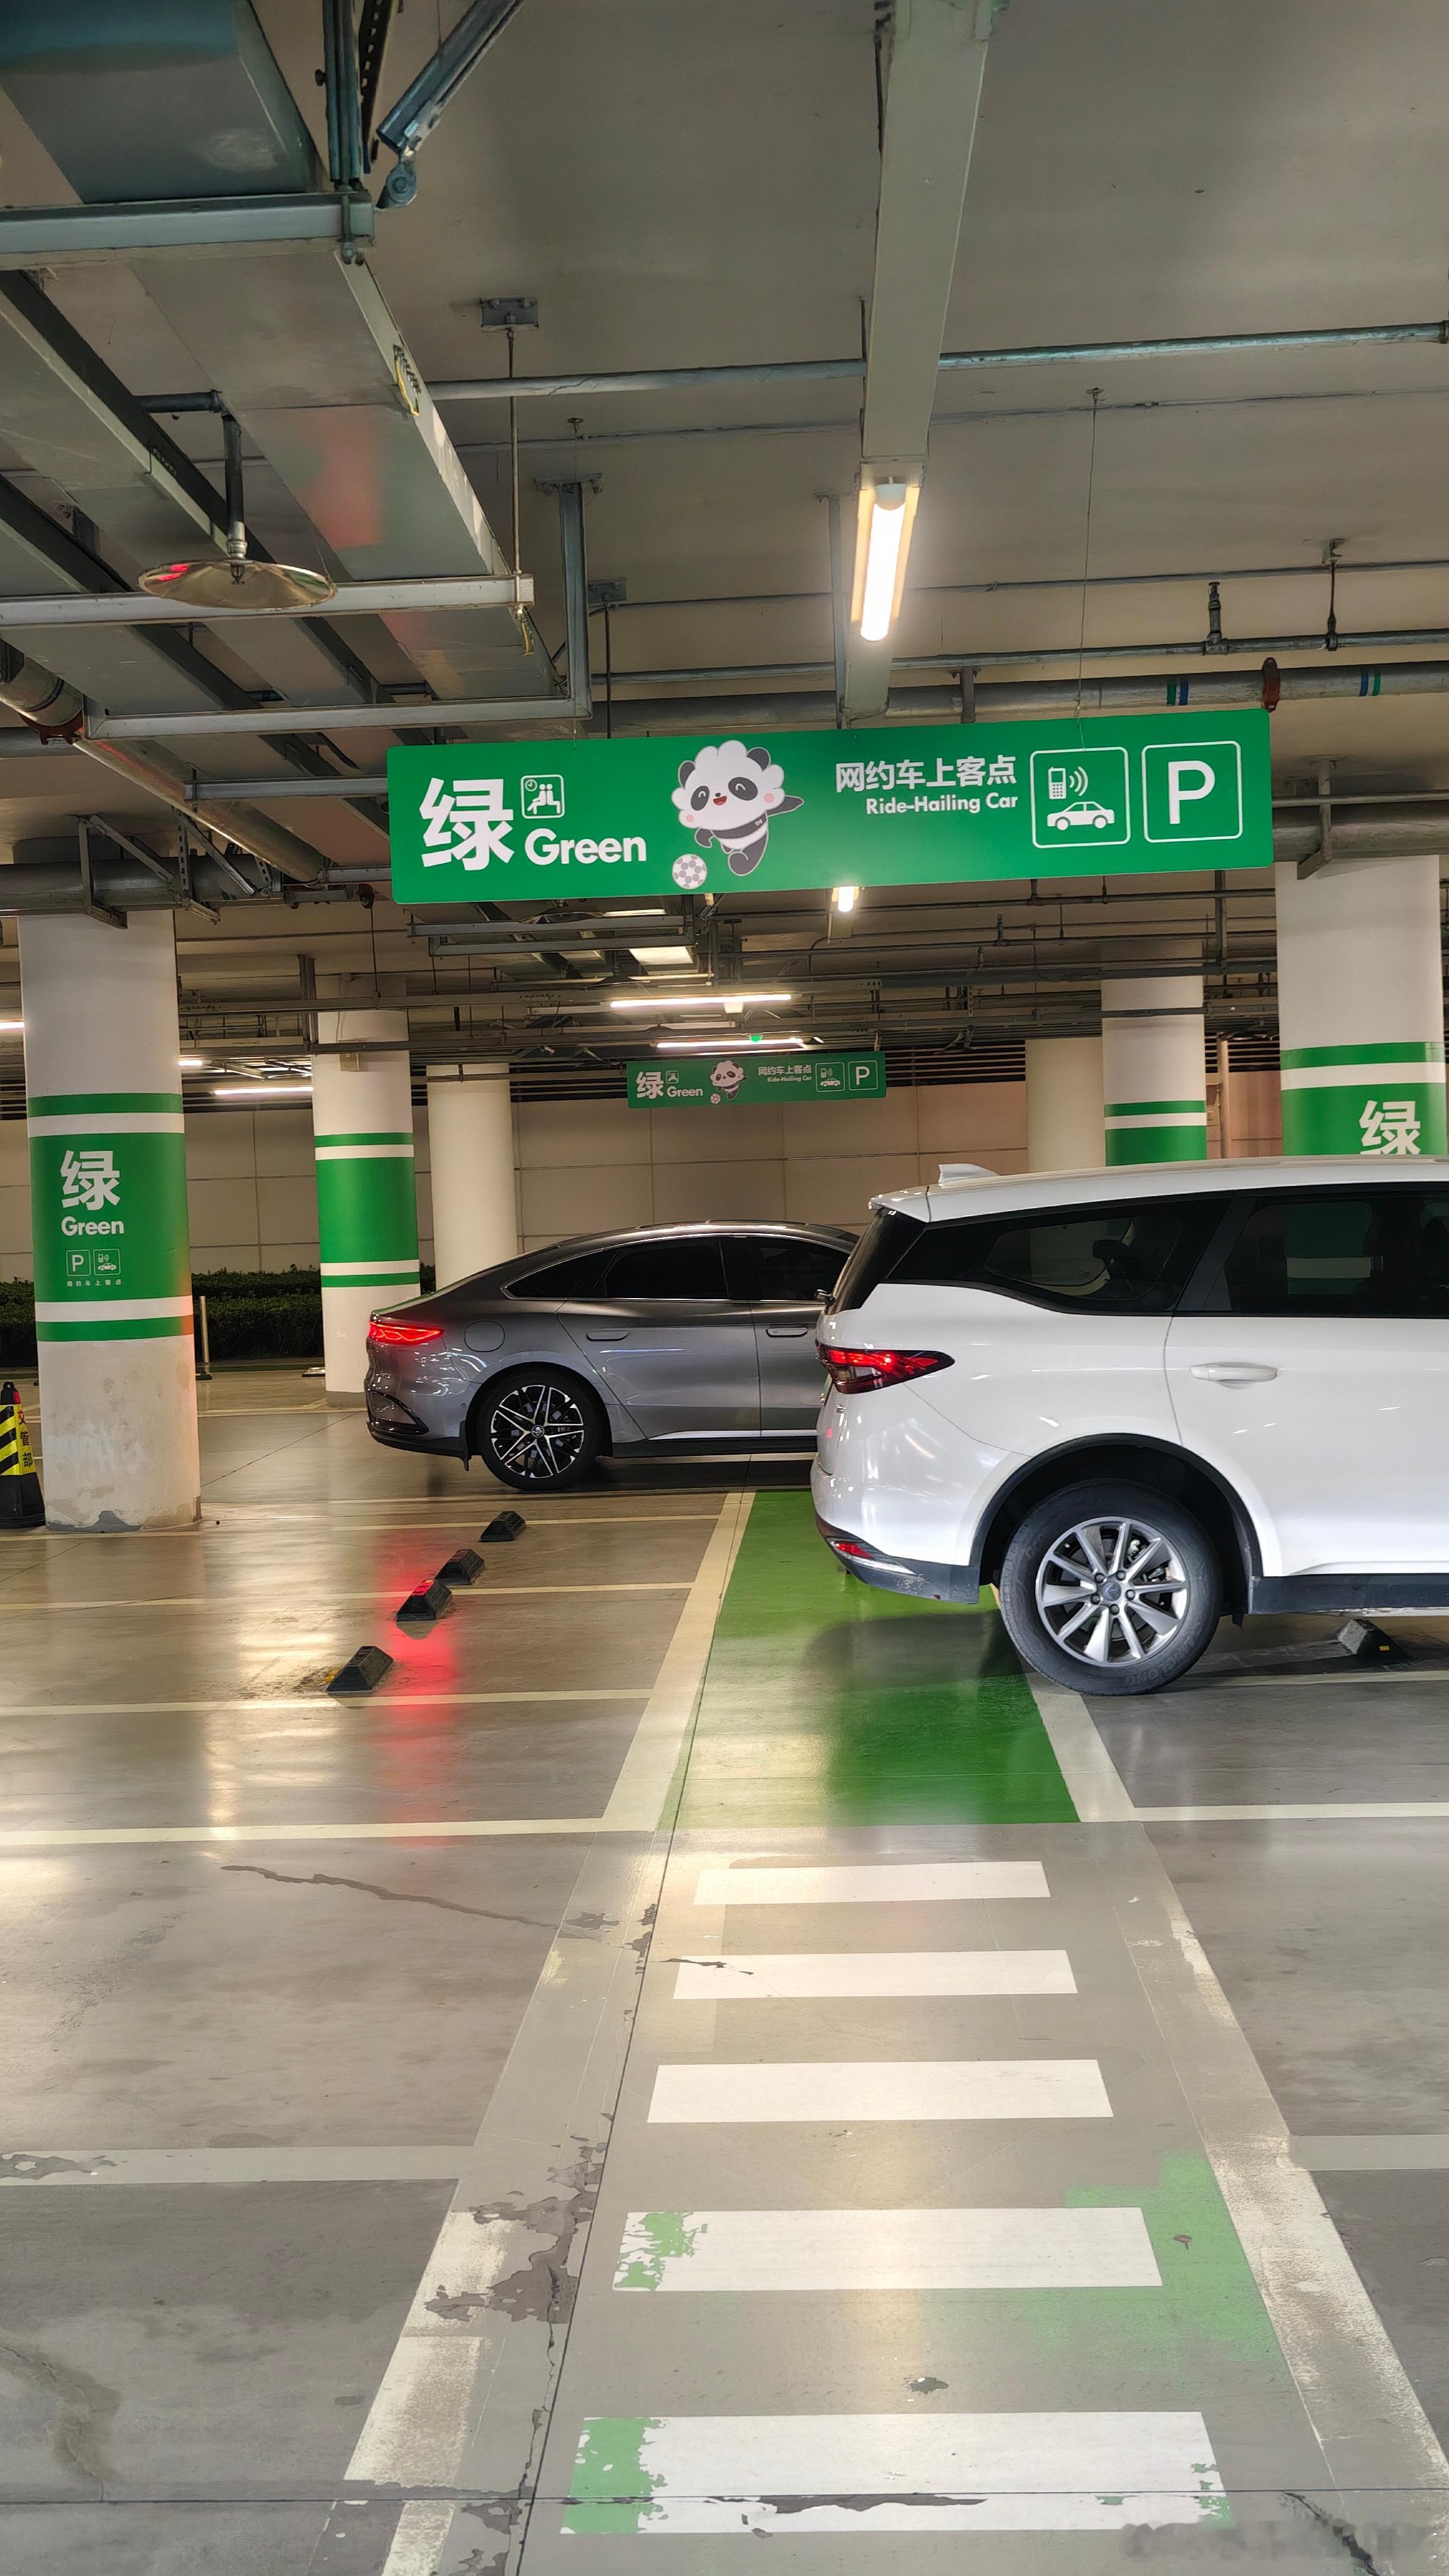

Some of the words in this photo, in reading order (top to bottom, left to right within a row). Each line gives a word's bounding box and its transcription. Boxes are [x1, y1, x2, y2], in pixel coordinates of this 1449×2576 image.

[836, 754, 1017, 793] 网约车上客点
[866, 794, 980, 814] Ride-Hailing
[985, 792, 1018, 809] Car
[1168, 760, 1216, 824] P
[419, 777, 514, 871] 绿
[525, 828, 647, 865] Green
[636, 1071, 664, 1099] 绿
[667, 1086, 703, 1097] Green
[855, 1066, 870, 1085] P
[1358, 1100, 1421, 1155] 绿
[60, 1150, 121, 1211] 绿
[61, 1216, 125, 1236] Green
[72, 1254, 84, 1272] P
